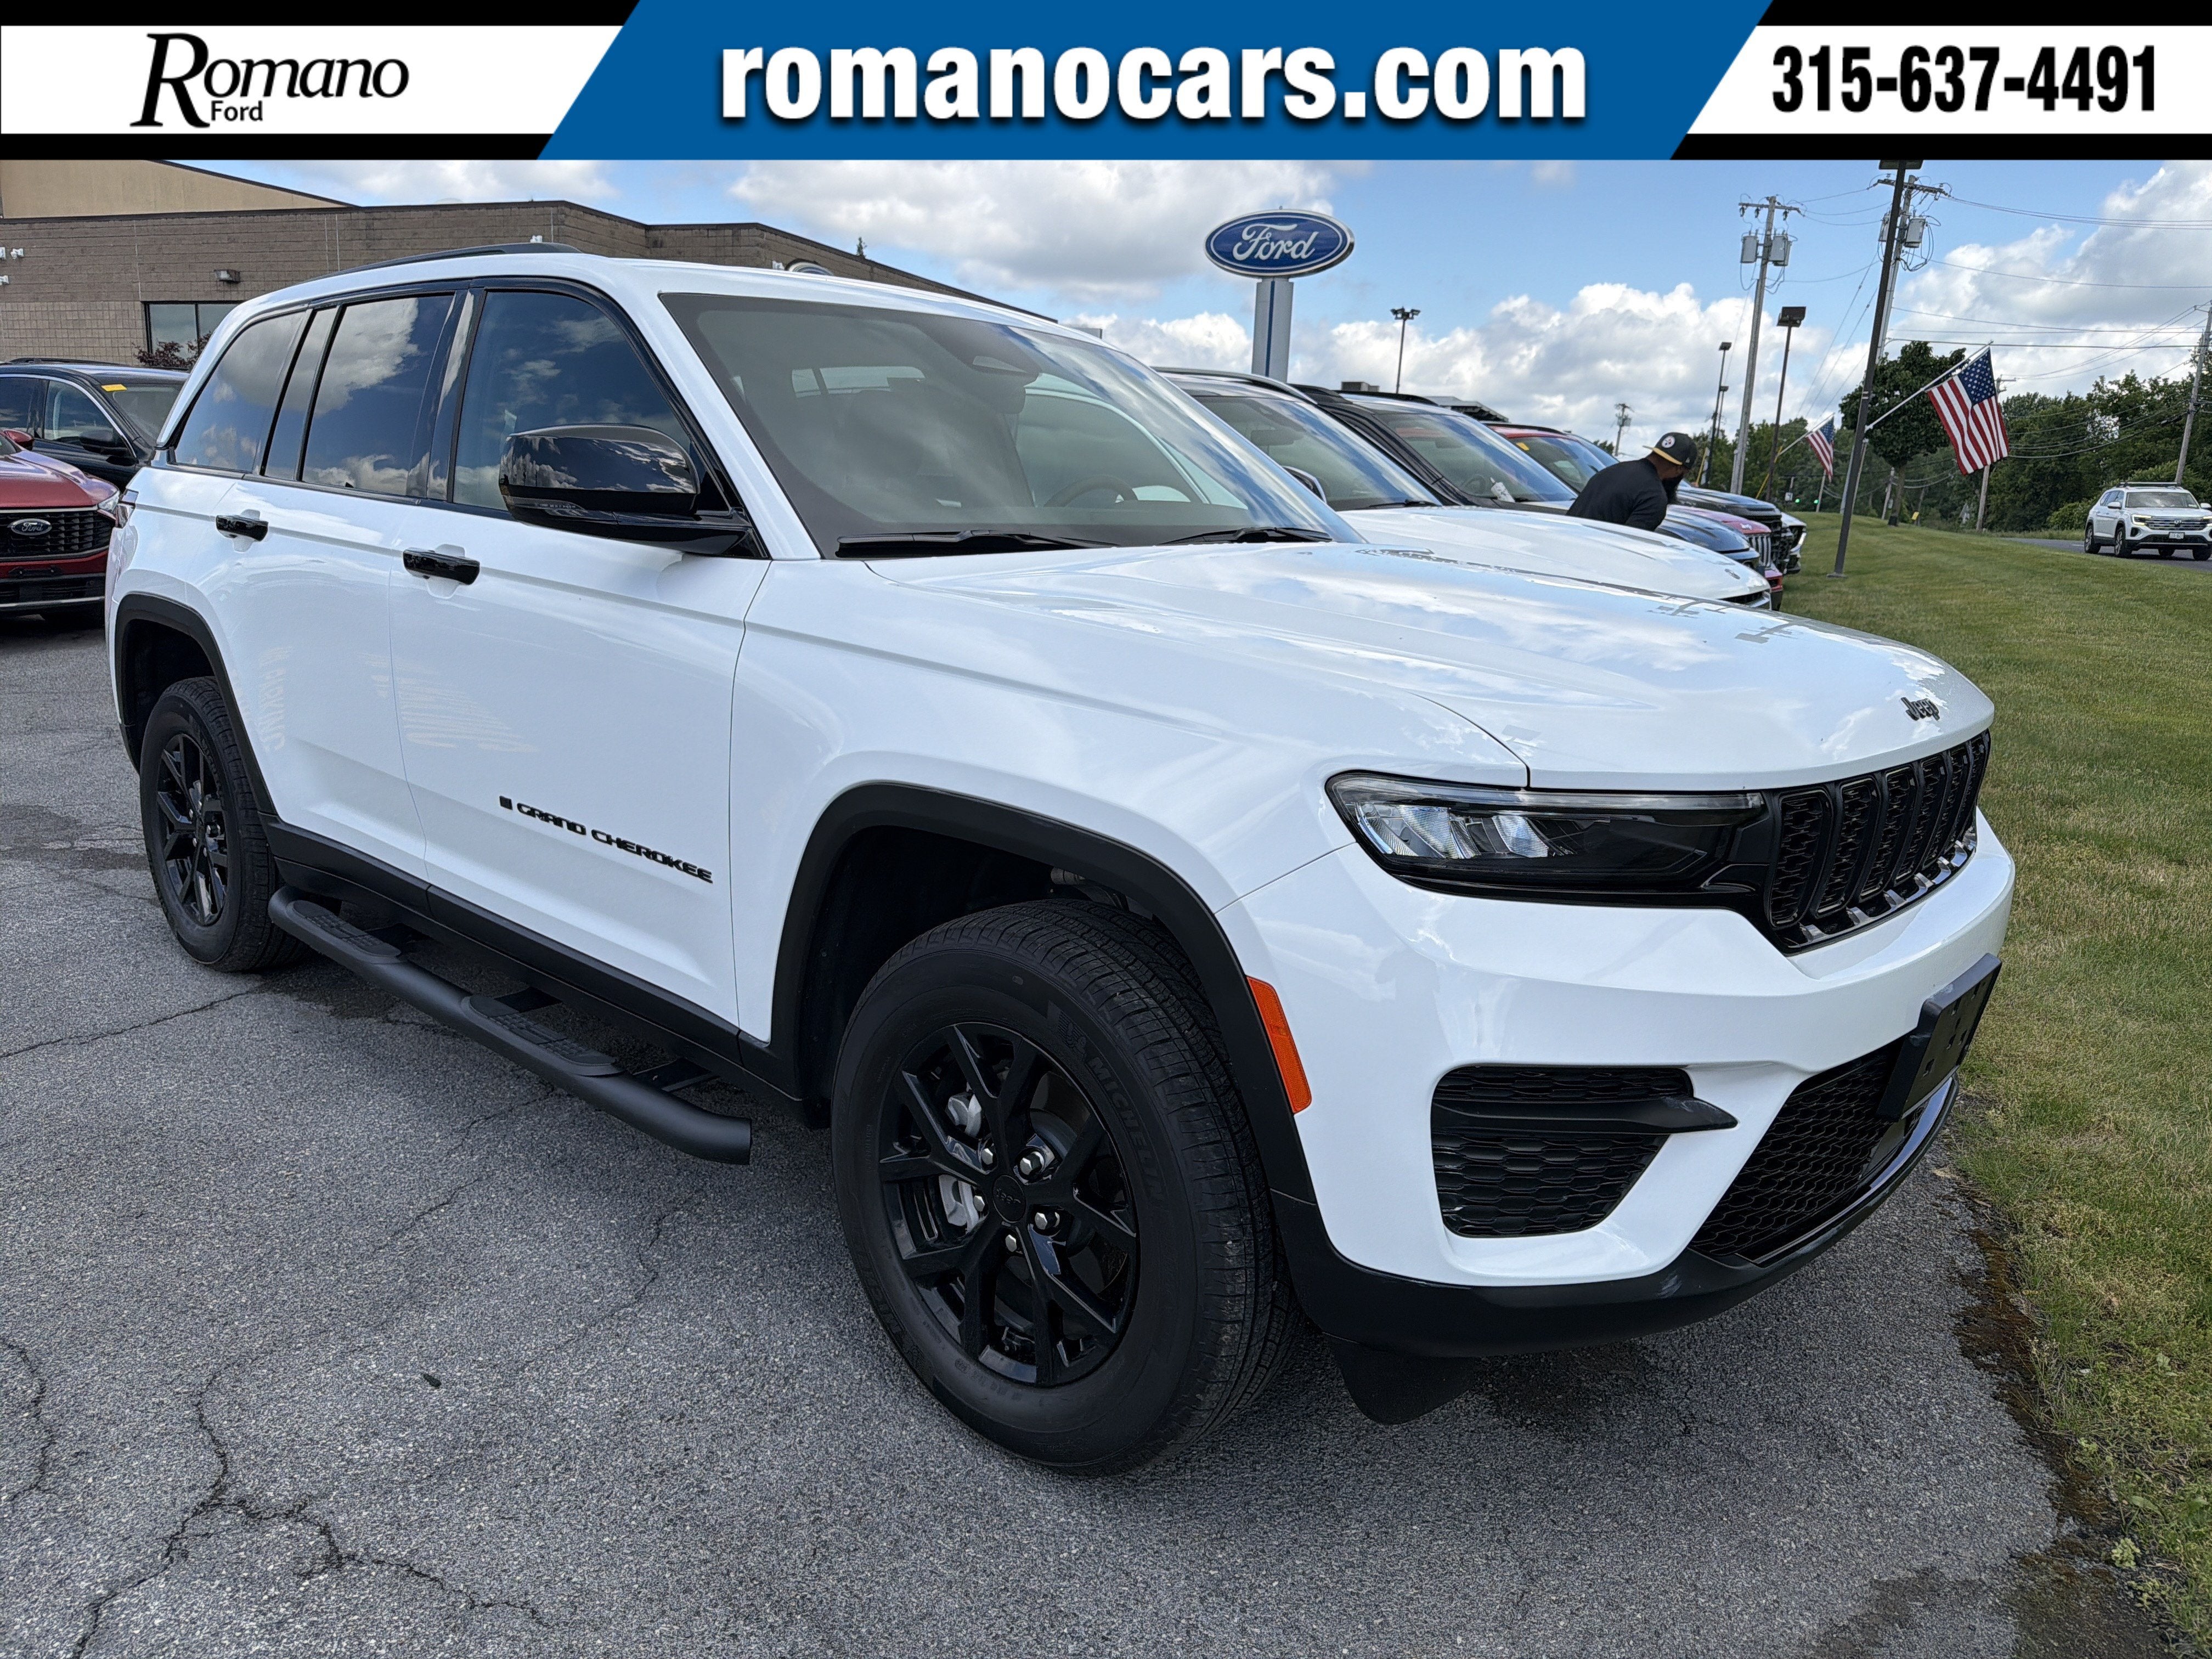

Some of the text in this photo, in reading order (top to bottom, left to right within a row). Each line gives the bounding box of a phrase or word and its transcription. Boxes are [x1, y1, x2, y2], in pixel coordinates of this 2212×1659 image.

[1233, 223, 1319, 261] Ford
[21, 522, 43, 532] Ford
[1900, 697, 1940, 721] Jeep
[517, 802, 713, 884] GRAND CHEROKEE
